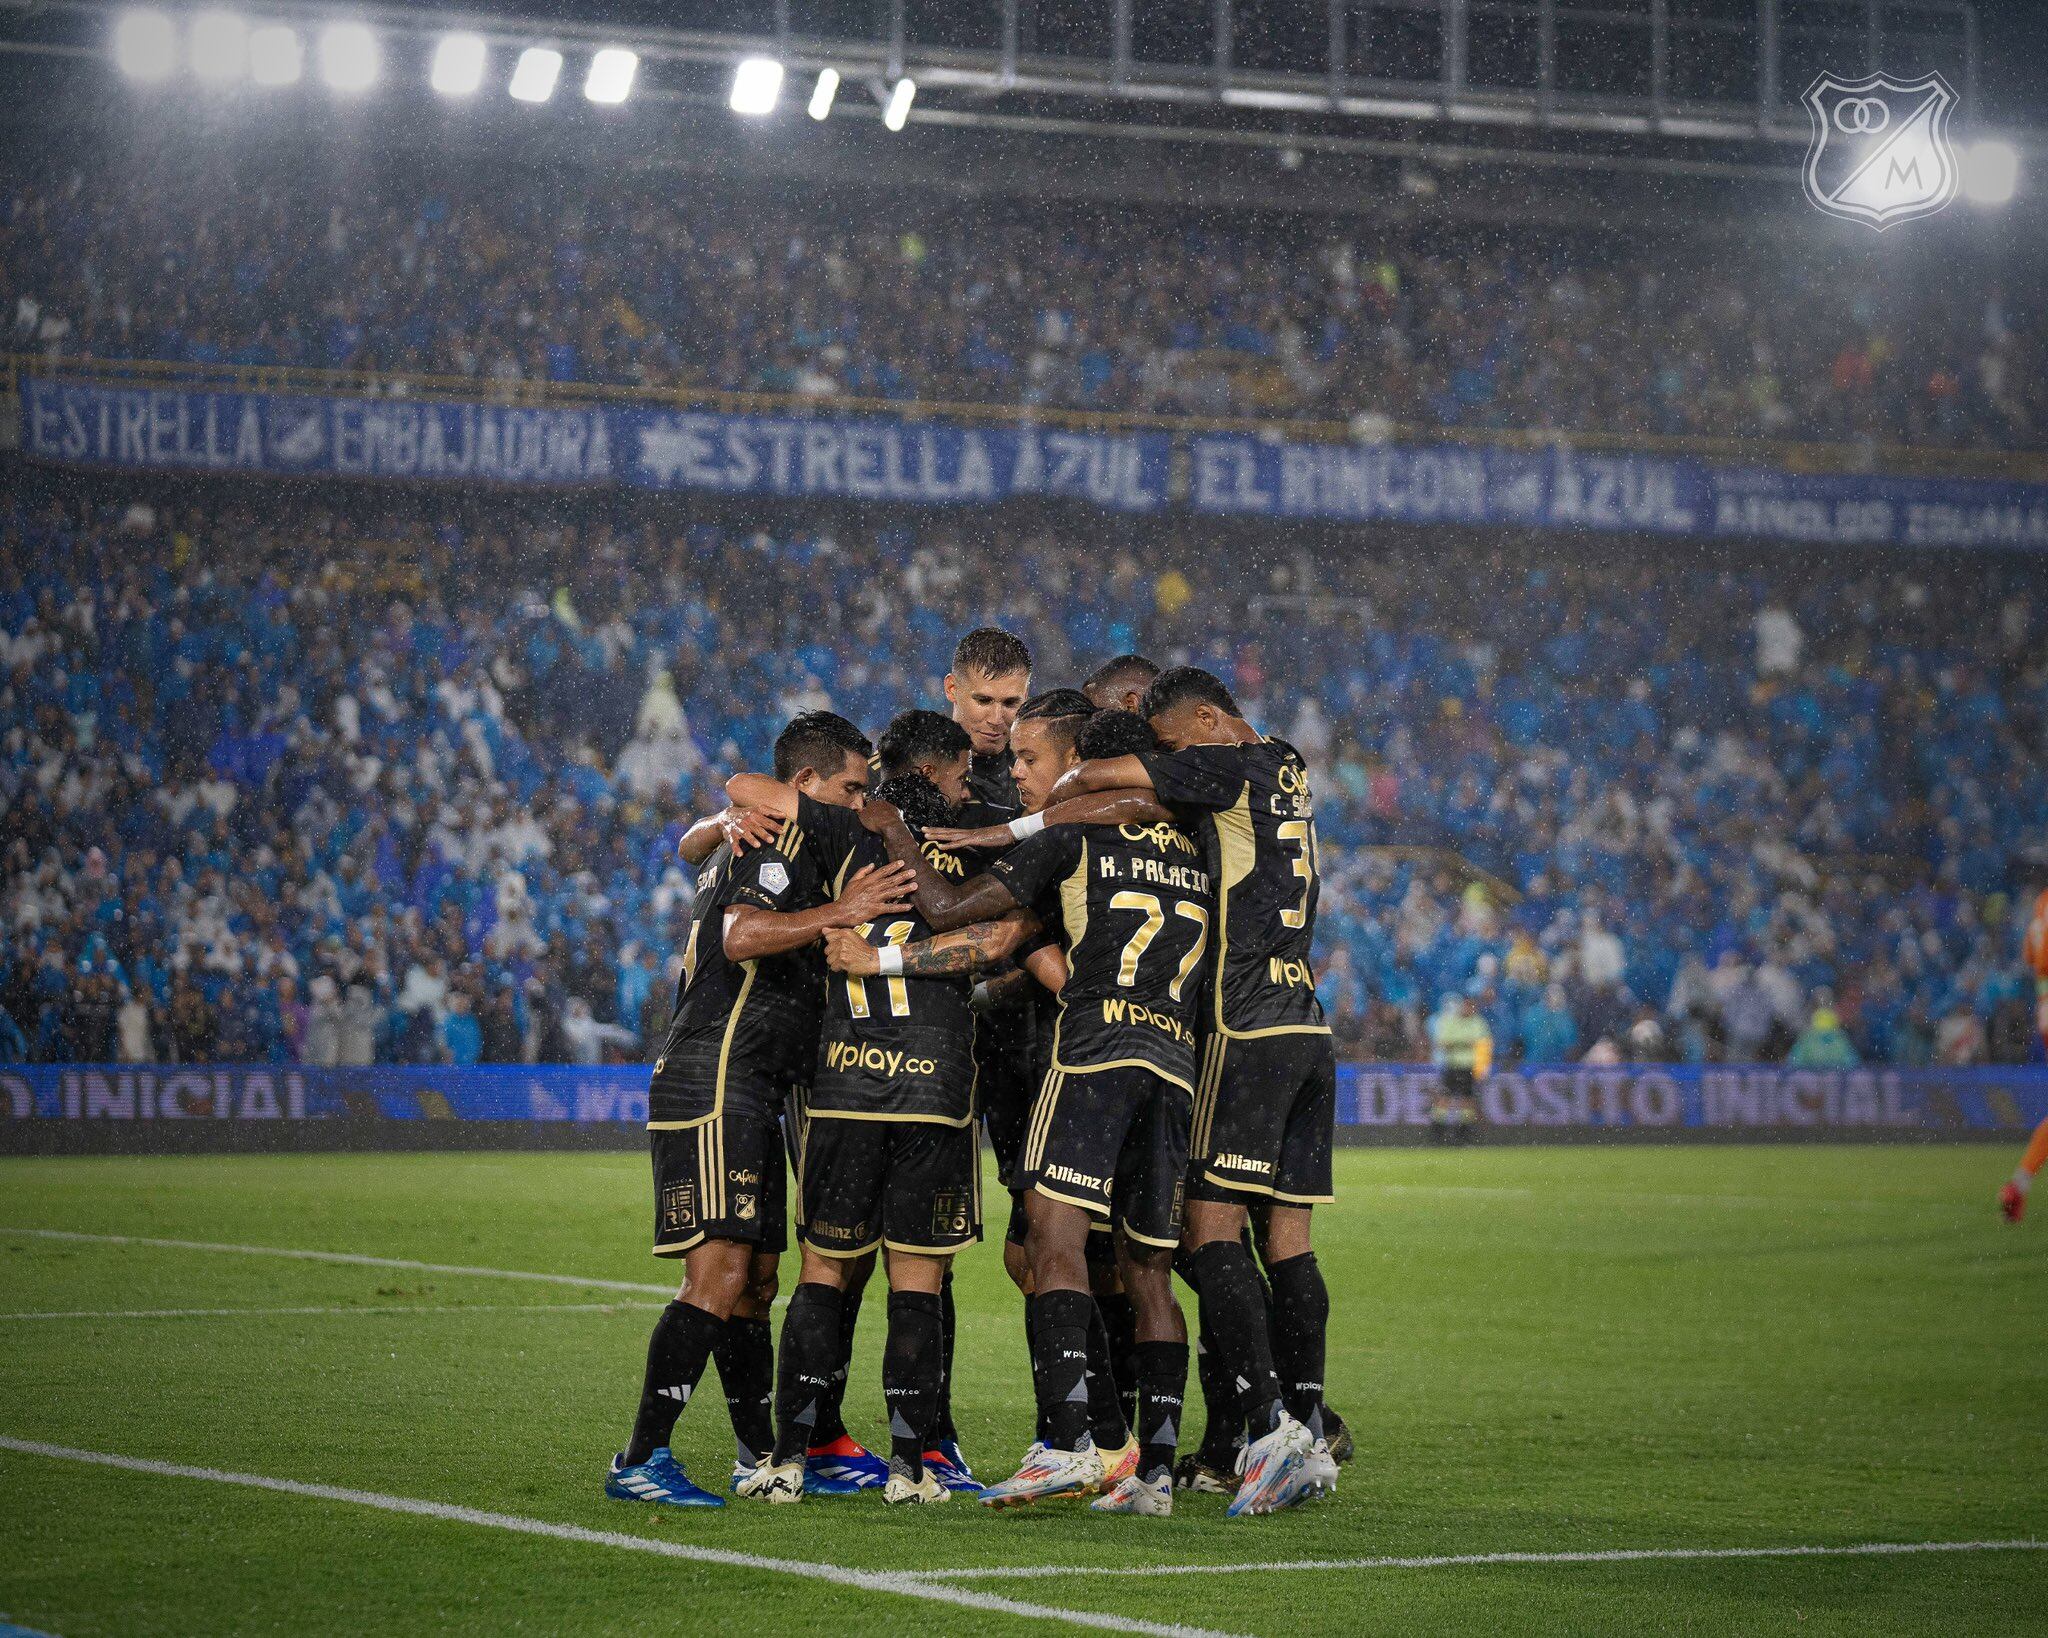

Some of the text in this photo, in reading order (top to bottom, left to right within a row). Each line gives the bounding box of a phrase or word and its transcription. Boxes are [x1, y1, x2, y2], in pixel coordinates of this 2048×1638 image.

[30, 386, 613, 481] ESTRELLA EMBAJADORA
[678, 412, 1157, 508] ESTRELLA AZUL
[1196, 438, 1272, 508] EL
[1550, 456, 1696, 530] AZUL
[1100, 855, 1213, 897] K. PALACIO
[1277, 820, 1320, 930] 3
[846, 920, 916, 1019] 11
[1109, 890, 1209, 1003] 77
[826, 1041, 938, 1078] Wplay.co
[62, 1071, 325, 1118] INICIAL
[1358, 1070, 1921, 1126] DEOSITO INICIAL
[1044, 1163, 1102, 1191] Allianz
[1213, 1152, 1272, 1175] Allianz
[811, 1220, 852, 1240] Allianz
[884, 1387, 920, 1397] play.co
